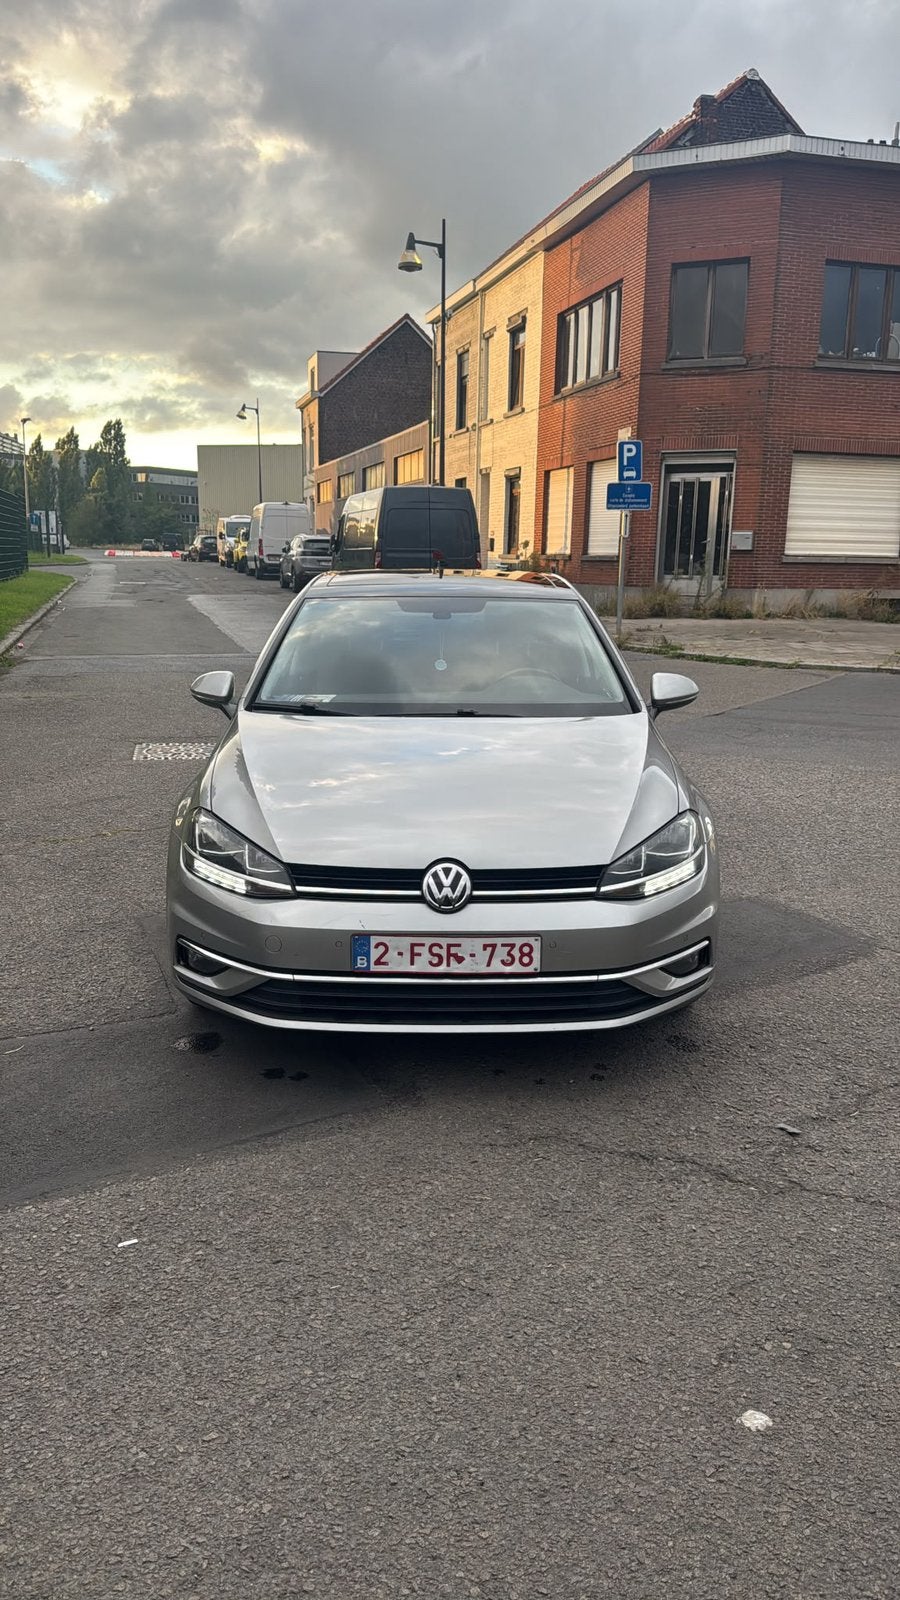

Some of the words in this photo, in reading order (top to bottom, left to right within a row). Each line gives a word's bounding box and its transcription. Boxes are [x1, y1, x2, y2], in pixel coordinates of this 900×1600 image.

[623, 444, 636, 466] P
[423, 862, 471, 908] VW
[356, 956, 367, 968] B
